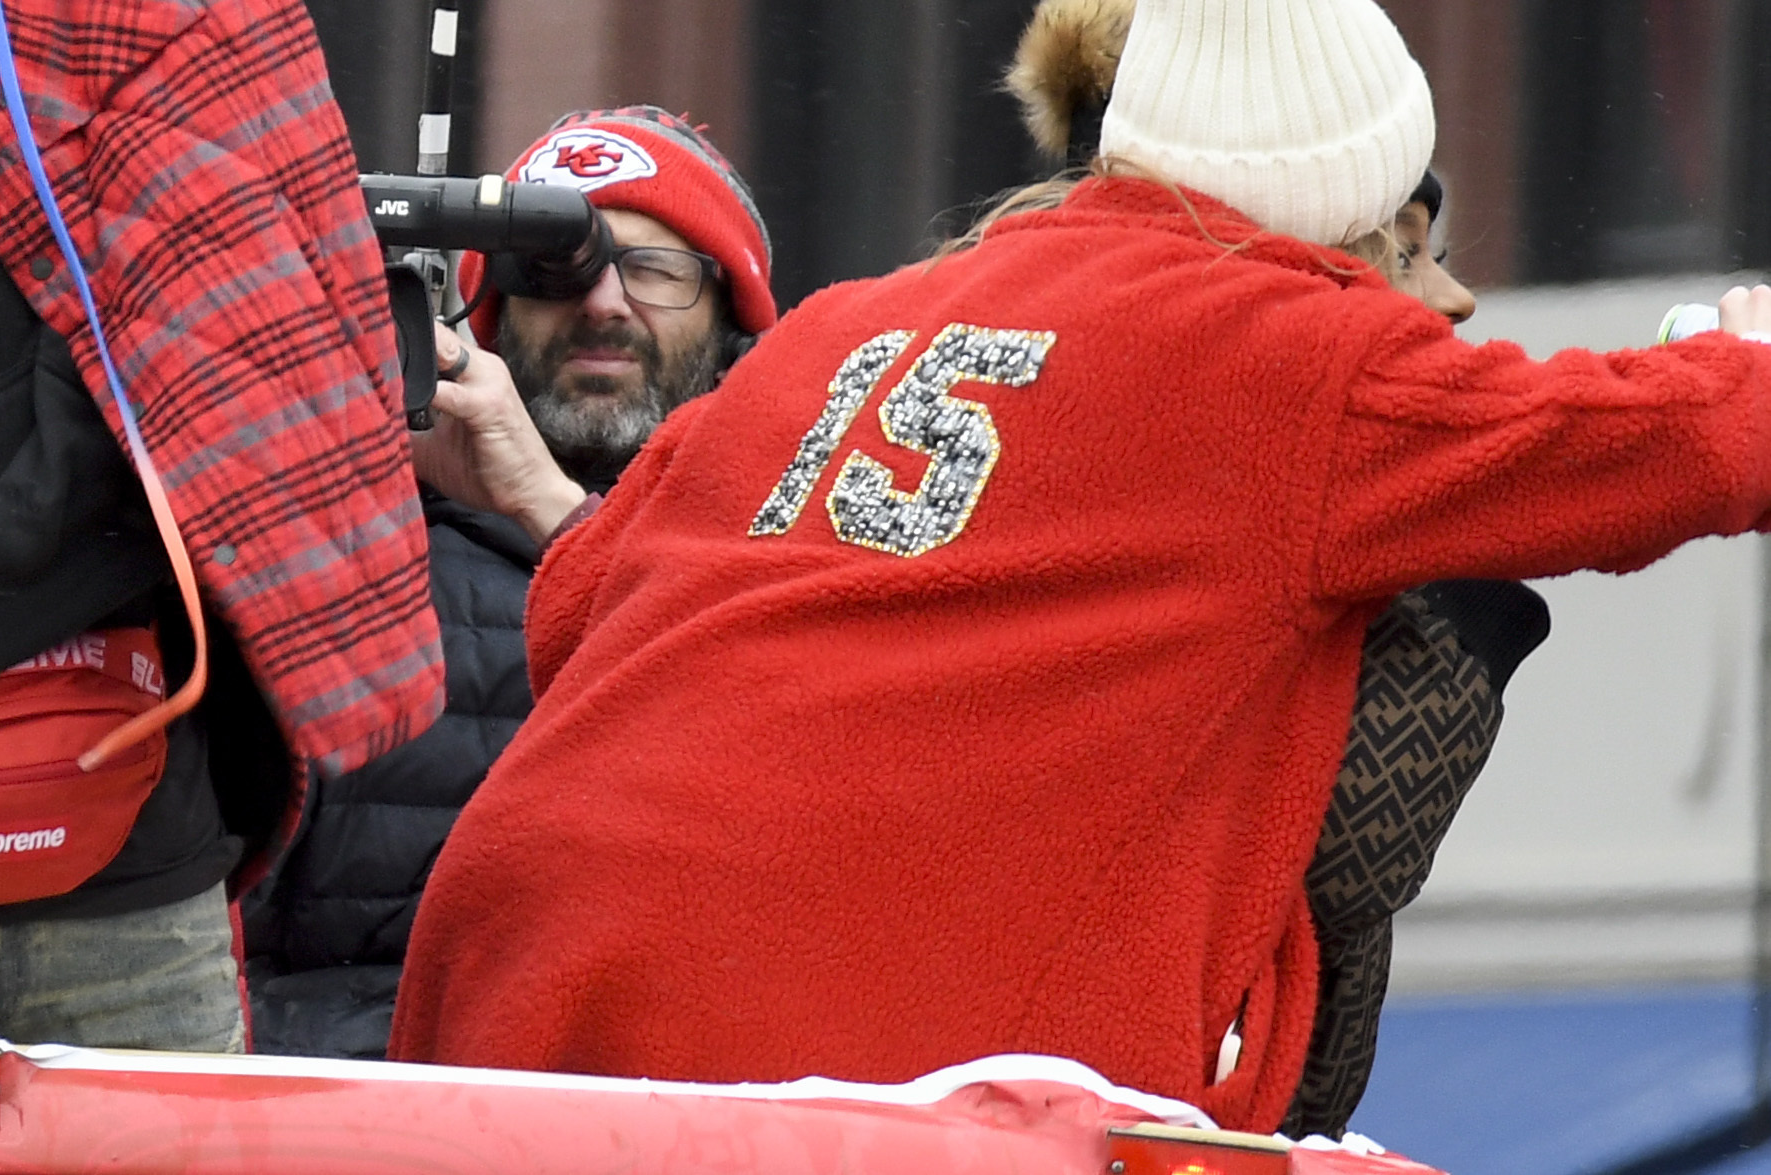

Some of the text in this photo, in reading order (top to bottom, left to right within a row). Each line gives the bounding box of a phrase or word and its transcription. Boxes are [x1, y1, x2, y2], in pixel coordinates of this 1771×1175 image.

[553, 142, 623, 178] KC
[375, 199, 410, 216] JVC
[746, 322, 1058, 559] 15
